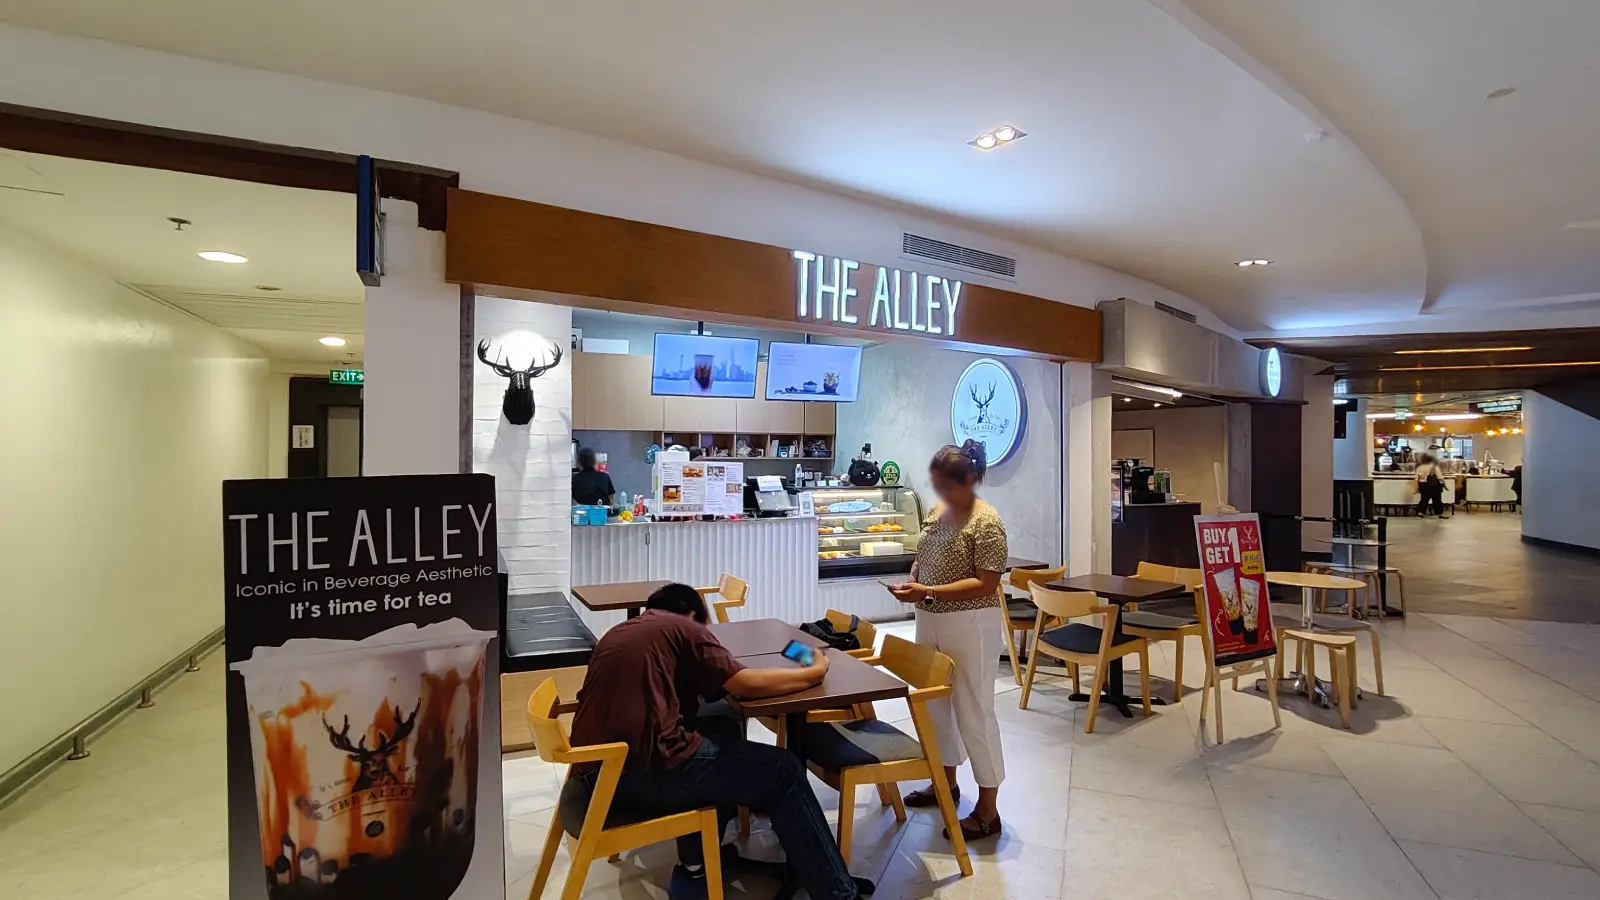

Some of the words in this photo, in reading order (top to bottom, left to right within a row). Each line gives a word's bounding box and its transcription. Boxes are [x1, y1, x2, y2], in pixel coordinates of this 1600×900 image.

[794, 250, 859, 324] THE
[870, 266, 962, 336] ALLEY
[332, 371, 357, 382] EXIT
[228, 511, 331, 574] THE
[348, 503, 493, 567] ALLEY
[1203, 528, 1227, 544] BUY
[1228, 527, 1241, 564] 1
[1205, 547, 1230, 564] GET
[236, 580, 297, 597] Iconic
[303, 578, 318, 592] in
[324, 573, 411, 590] Beverage
[416, 564, 493, 583] Aesthetic
[290, 601, 322, 620] It's
[328, 598, 378, 616] time
[384, 594, 412, 611] for
[418, 591, 452, 607] tea
[327, 793, 360, 814] THE
